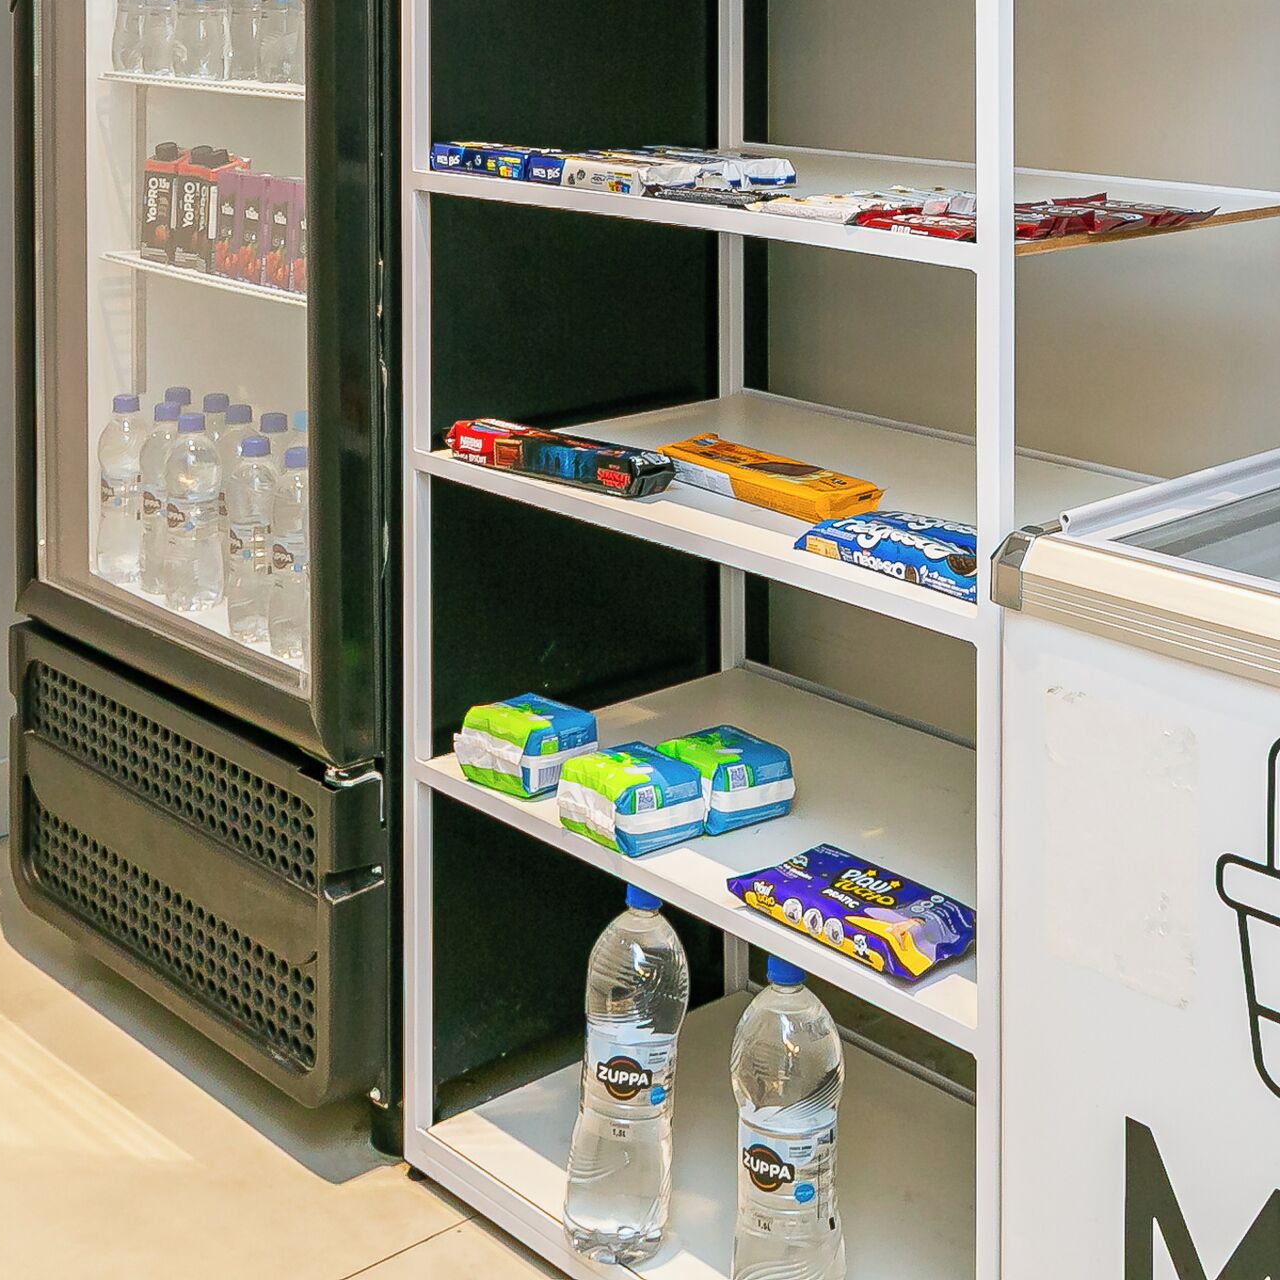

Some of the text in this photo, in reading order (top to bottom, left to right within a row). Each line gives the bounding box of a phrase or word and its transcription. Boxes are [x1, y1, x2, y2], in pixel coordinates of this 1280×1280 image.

[822, 888, 860, 910] PRATIC
[598, 1065, 650, 1087] ZUPPA
[743, 1151, 792, 1181] ZUPPA
